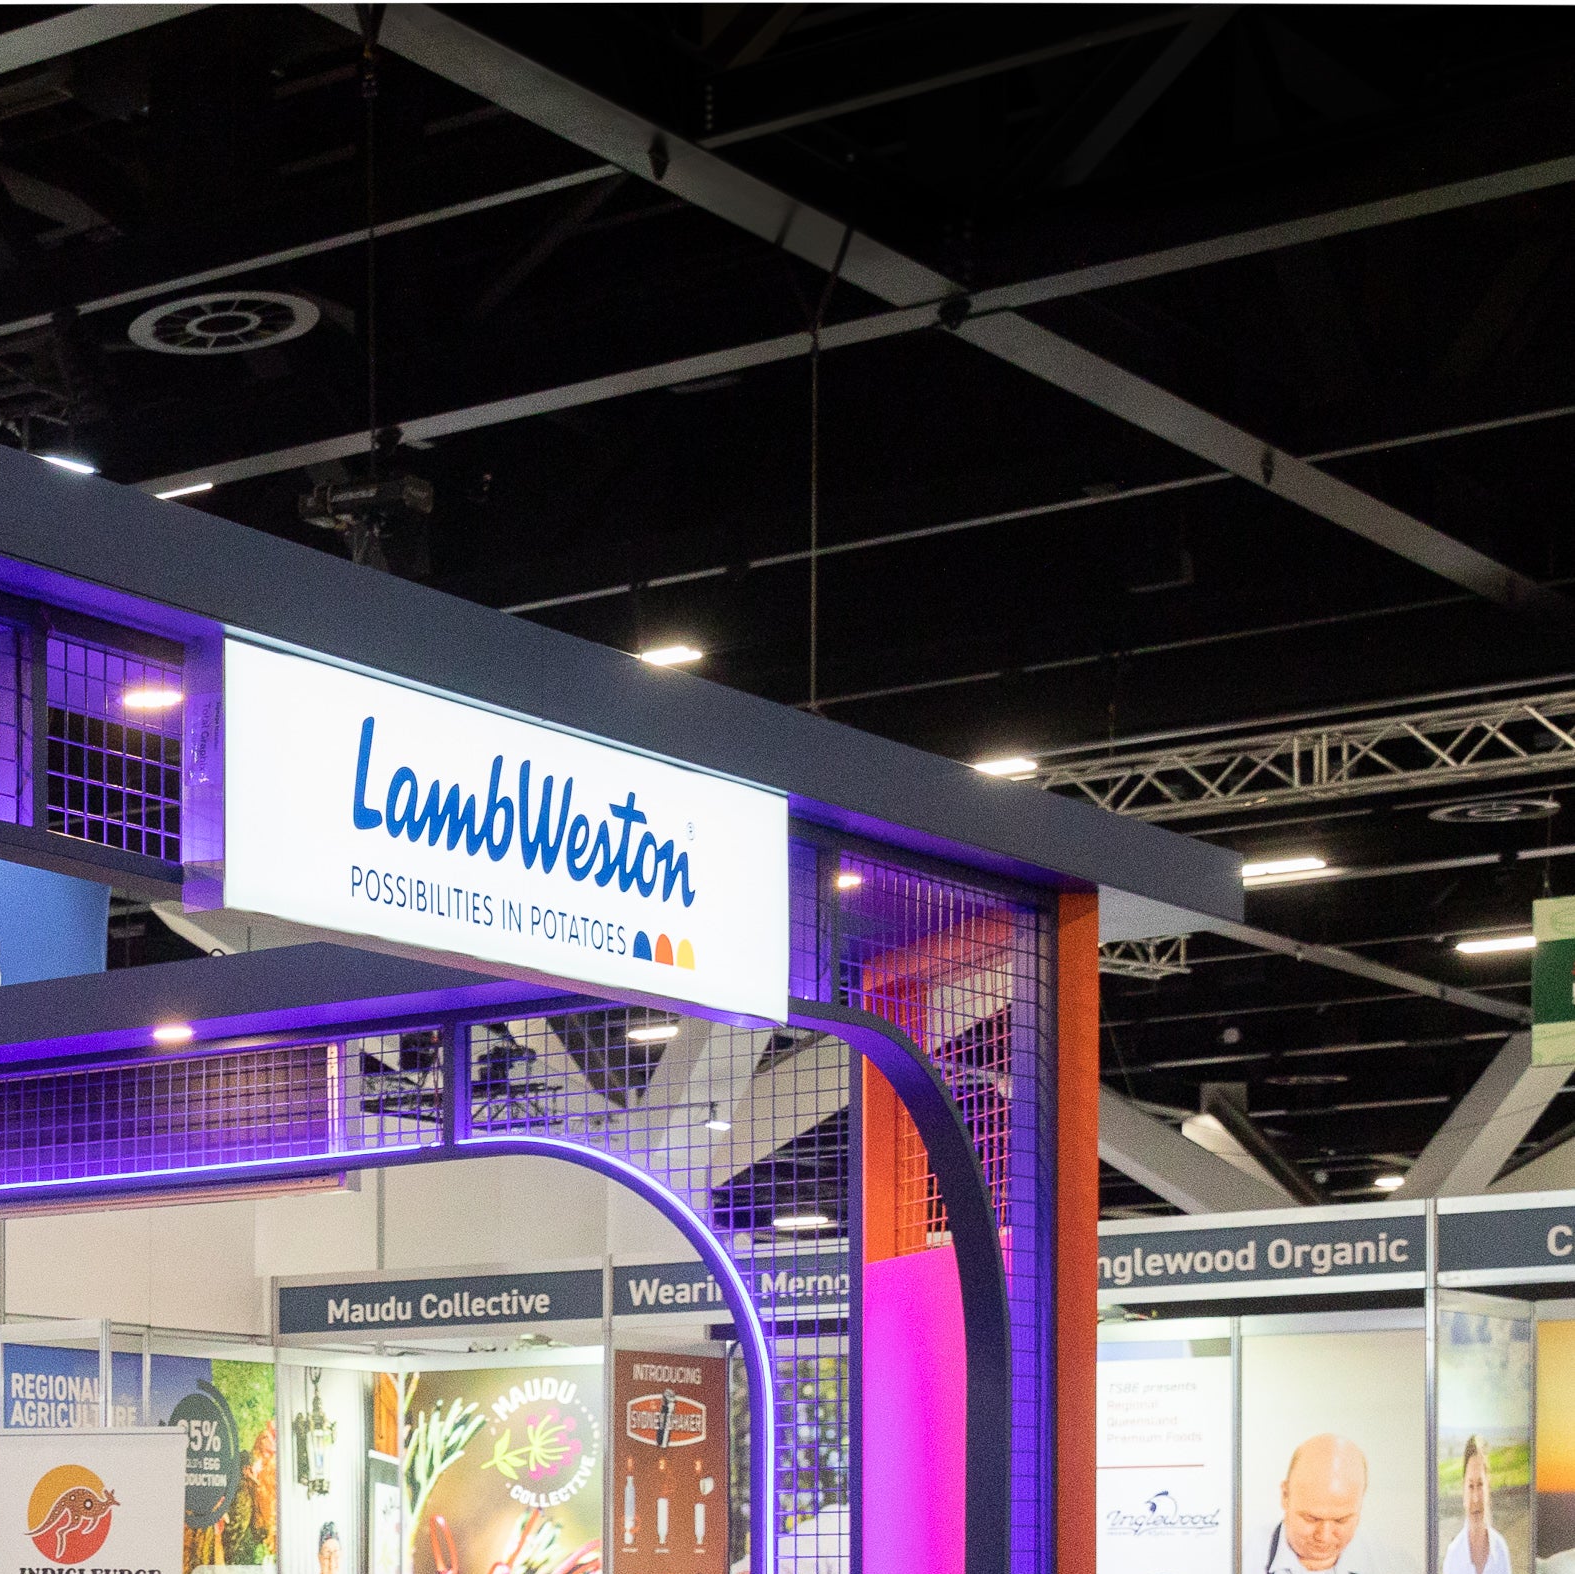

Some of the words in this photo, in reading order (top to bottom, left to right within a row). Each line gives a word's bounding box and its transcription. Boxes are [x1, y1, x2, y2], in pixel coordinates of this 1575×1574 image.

[352, 716, 696, 907] LambWeston
[351, 865, 493, 926] POSSIBILITIES
[502, 899, 522, 933] IN
[531, 905, 627, 956] POTATOES
[1268, 1233, 1409, 1276] Organic
[328, 1296, 412, 1325] Maudu
[420, 1289, 551, 1319] Collective
[633, 1363, 702, 1385] INTRODUCING
[1143, 1381, 1198, 1395] presents
[491, 1377, 578, 1421] MAUDU
[510, 1455, 596, 1507] COLLECTIVE
